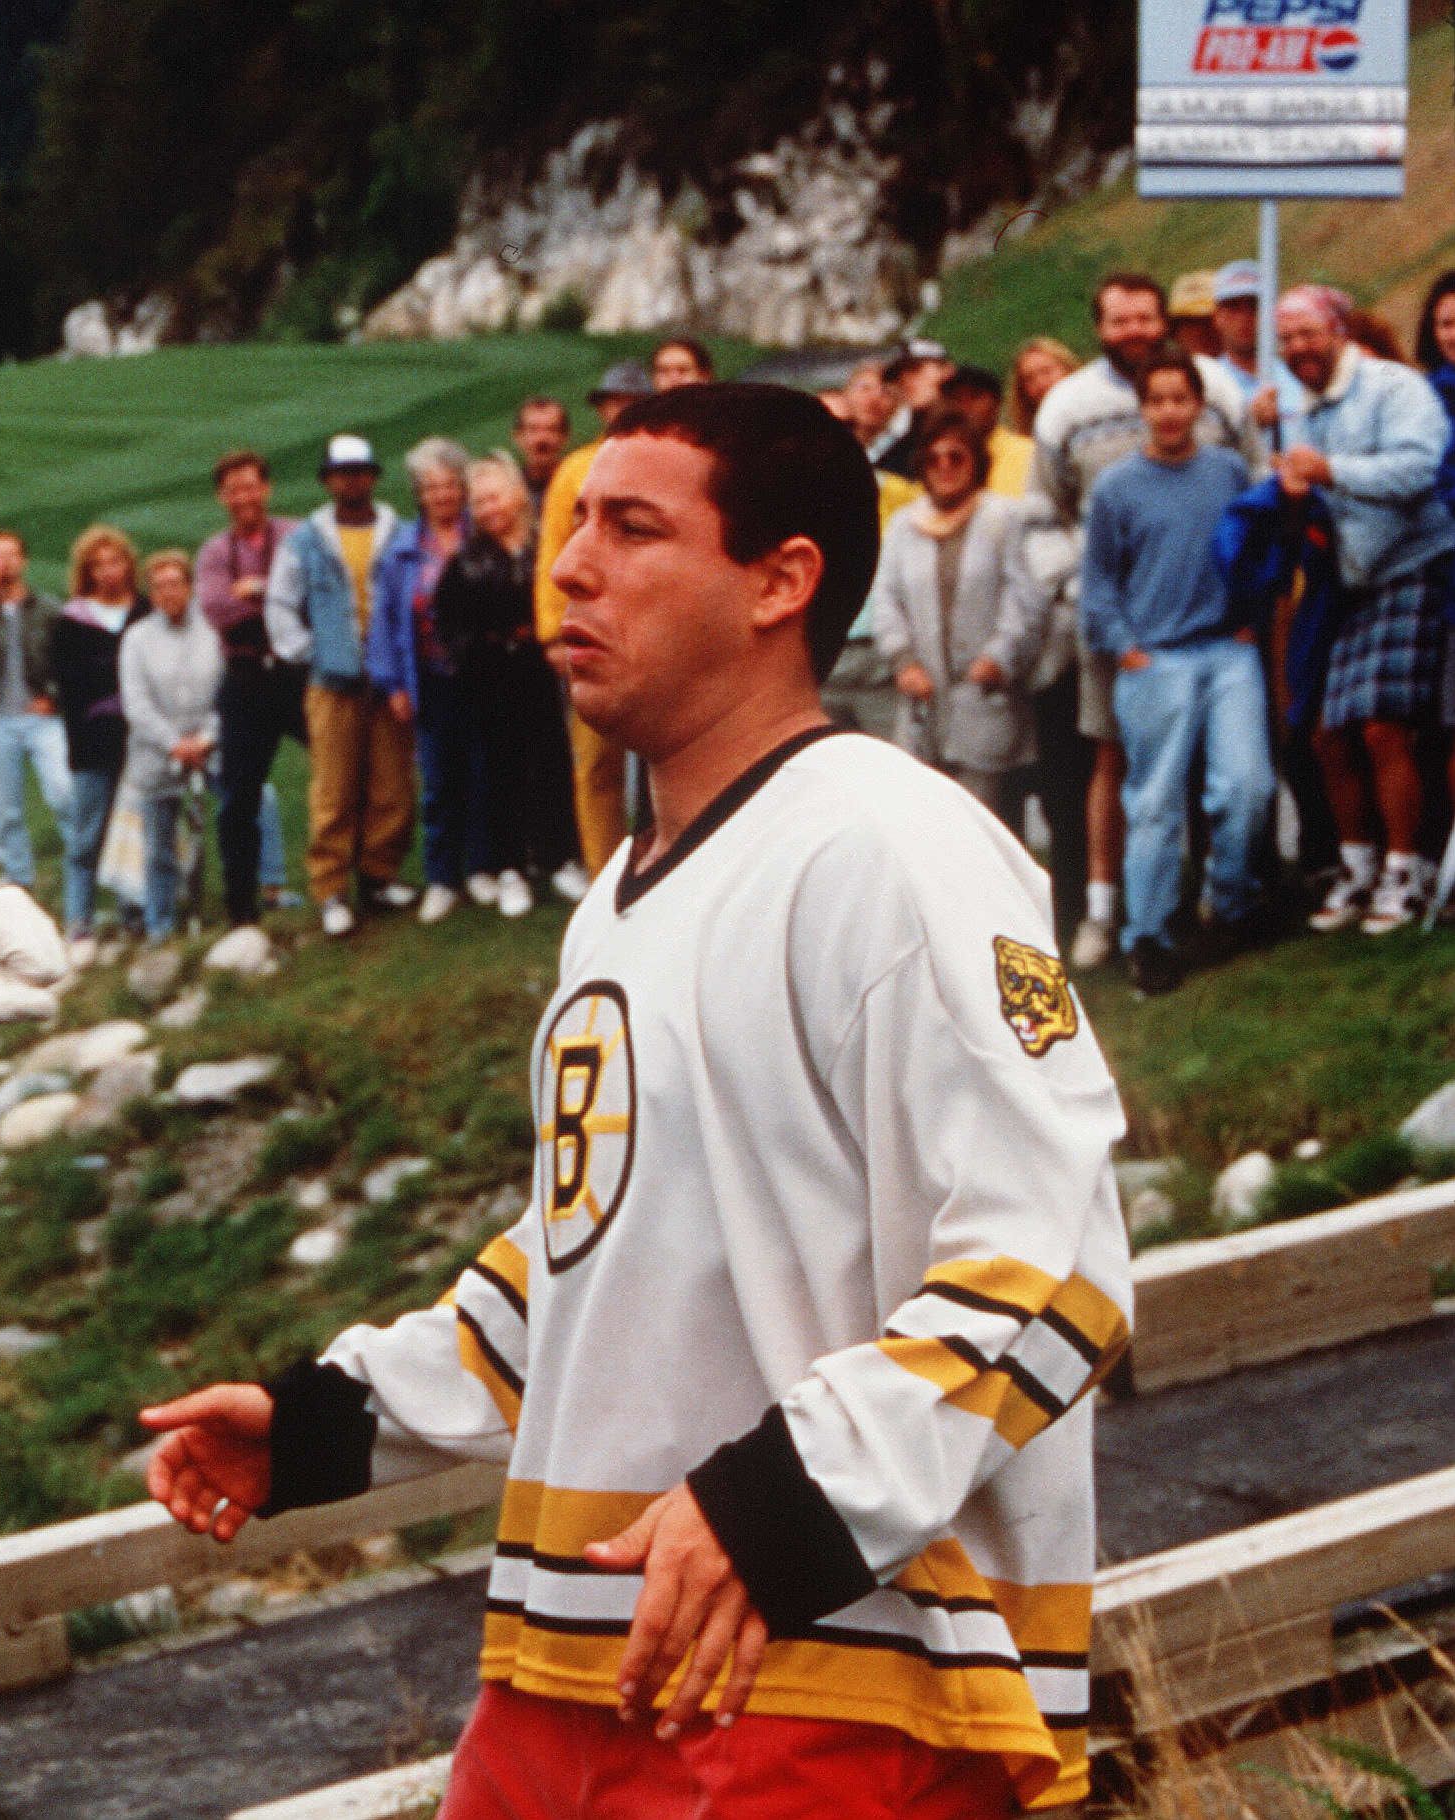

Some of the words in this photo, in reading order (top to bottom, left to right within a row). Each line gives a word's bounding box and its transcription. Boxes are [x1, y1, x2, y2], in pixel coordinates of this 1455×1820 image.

[1202, 0, 1364, 24] PEPSI
[1199, 29, 1309, 71] PRO-AM
[550, 1038, 604, 1219] B
